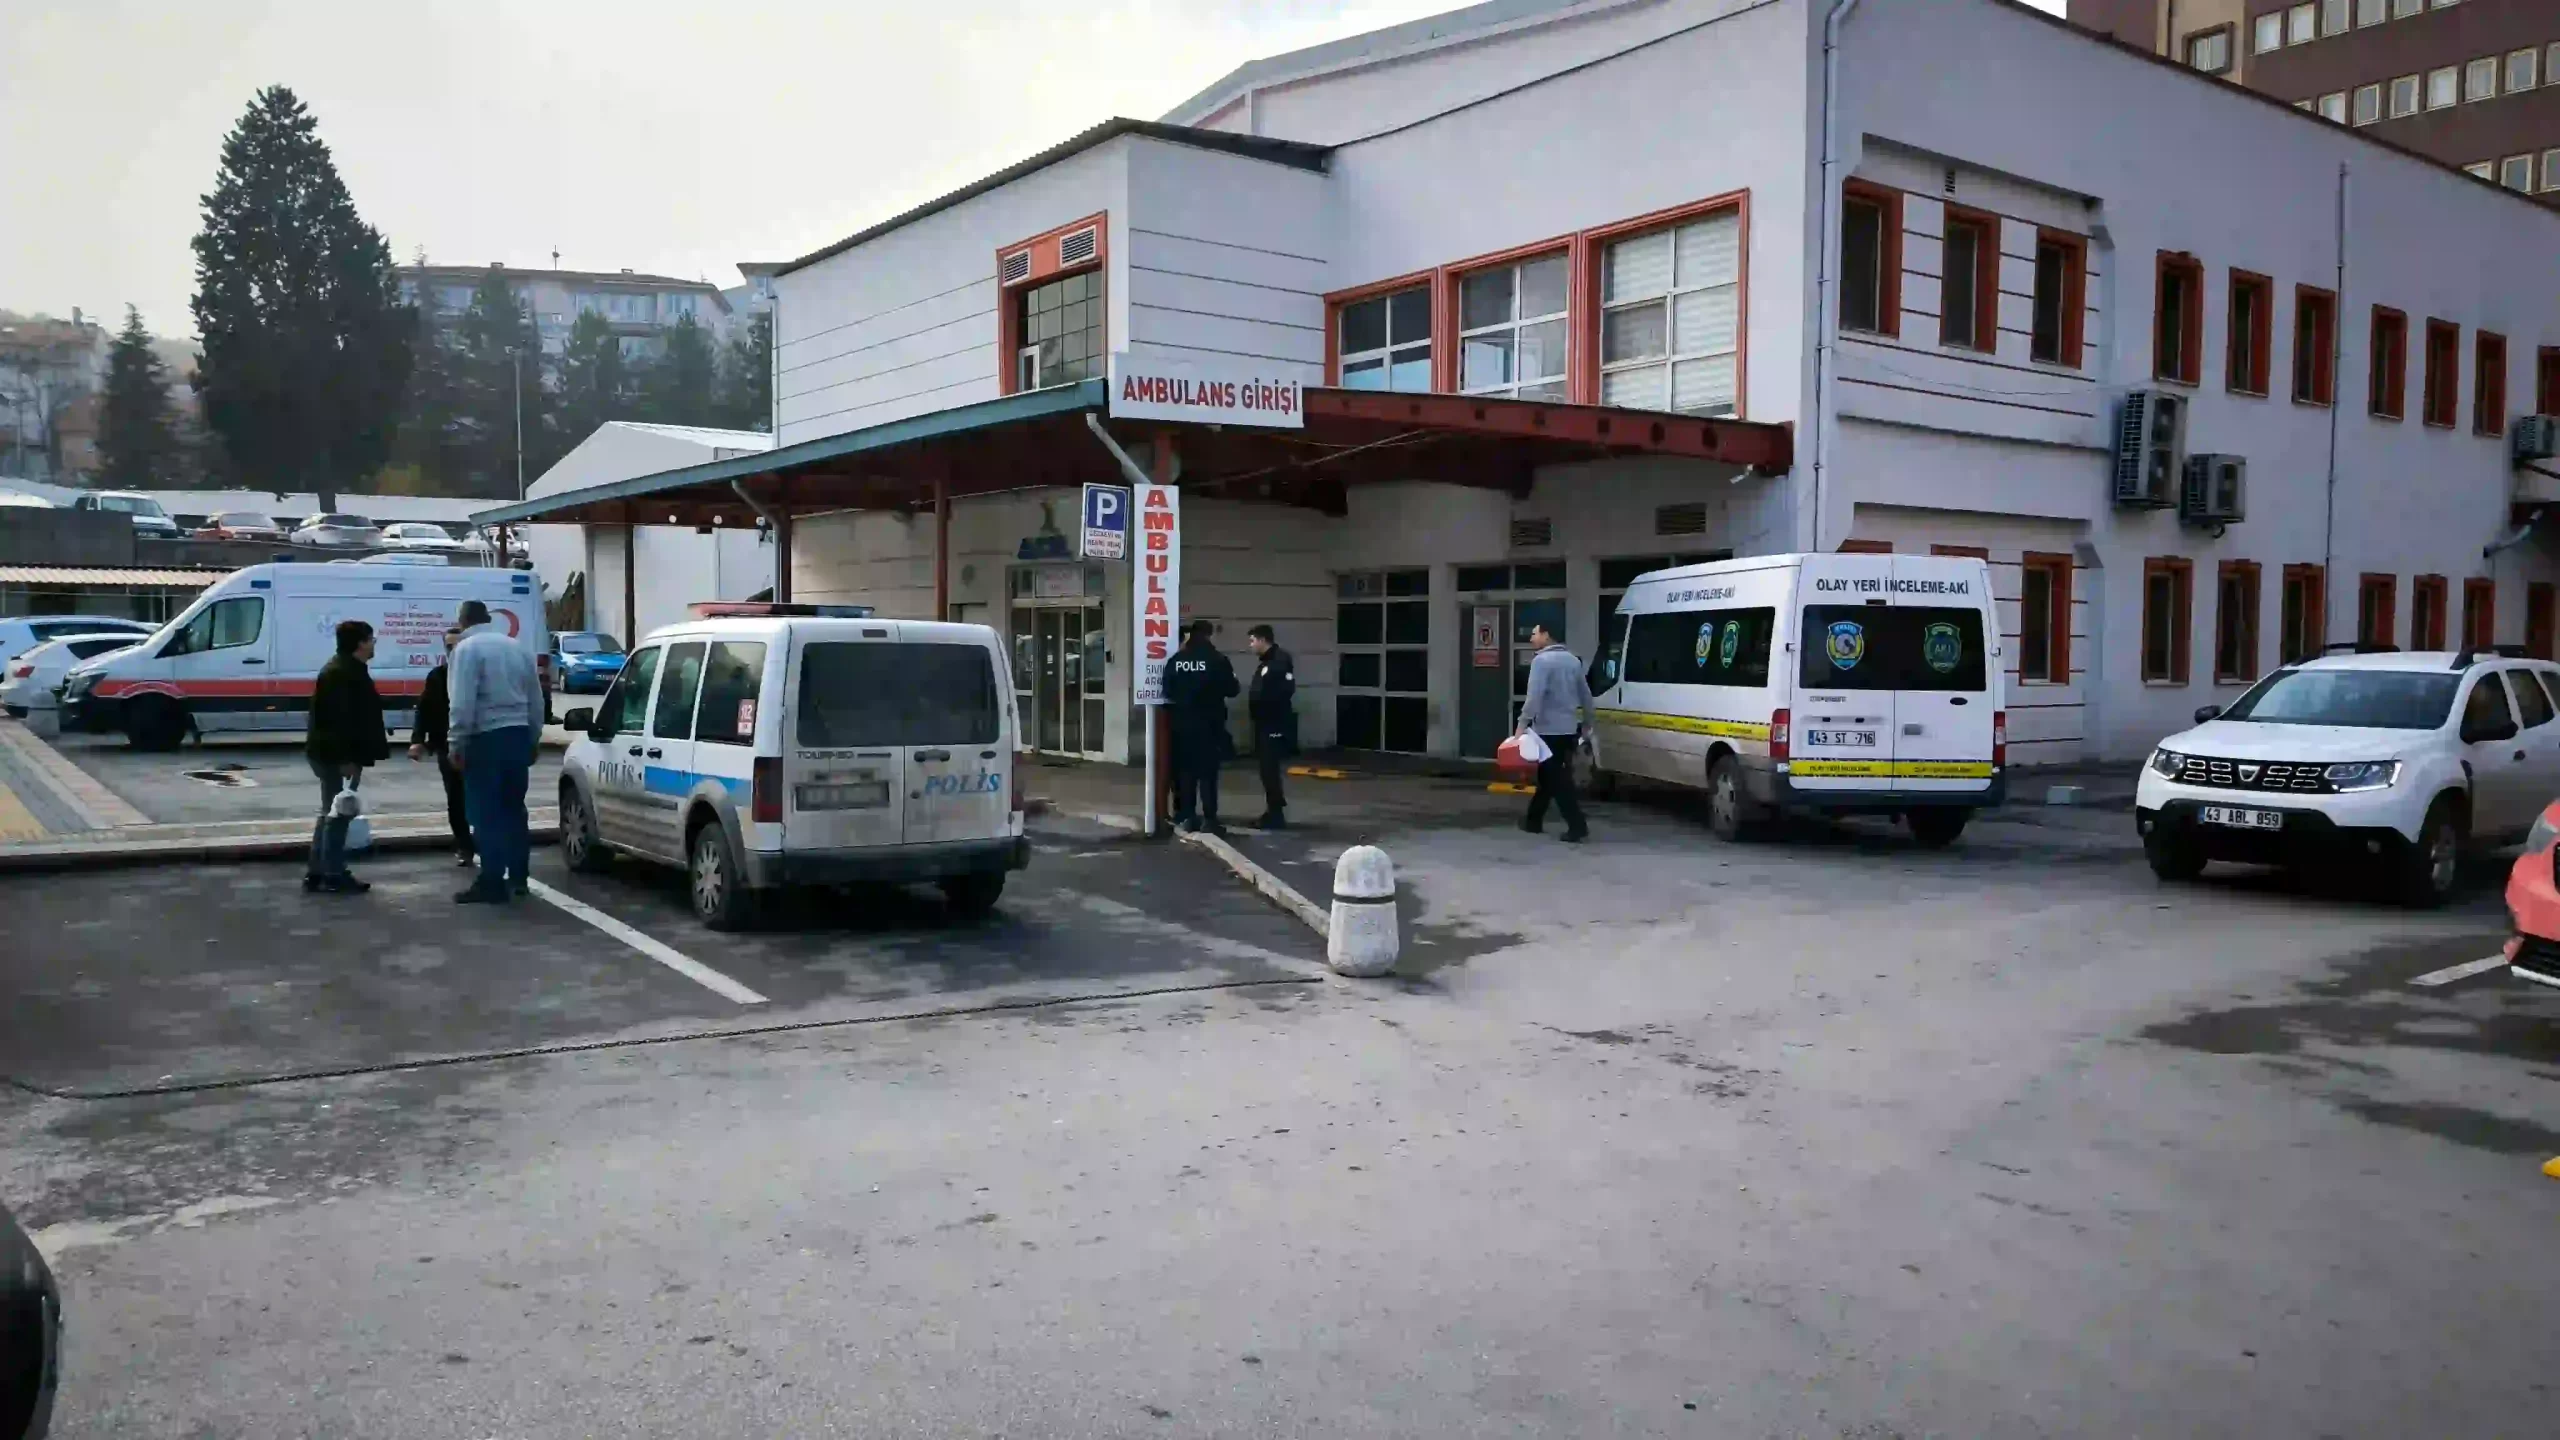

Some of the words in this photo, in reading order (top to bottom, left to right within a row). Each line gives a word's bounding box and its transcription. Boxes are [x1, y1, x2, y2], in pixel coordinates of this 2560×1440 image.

[1123, 375, 1236, 408] AMBULANS
[1241, 377, 1298, 415] GİRİŞİ
[1096, 492, 1118, 527] P
[1143, 489, 1174, 660] AMBULANS
[1816, 578, 1849, 592] OLAY
[1853, 577, 1881, 592] YERİ
[1885, 576, 1969, 595] İNCELEME-AKİ
[1145, 676, 1163, 686] ARA
[1835, 732, 1847, 743] ST
[598, 760, 635, 785] POLİS
[924, 766, 1001, 795] POLİS
[2206, 807, 2221, 821] 43
[2227, 809, 2250, 824] ABL
[2256, 812, 2279, 827] 859
